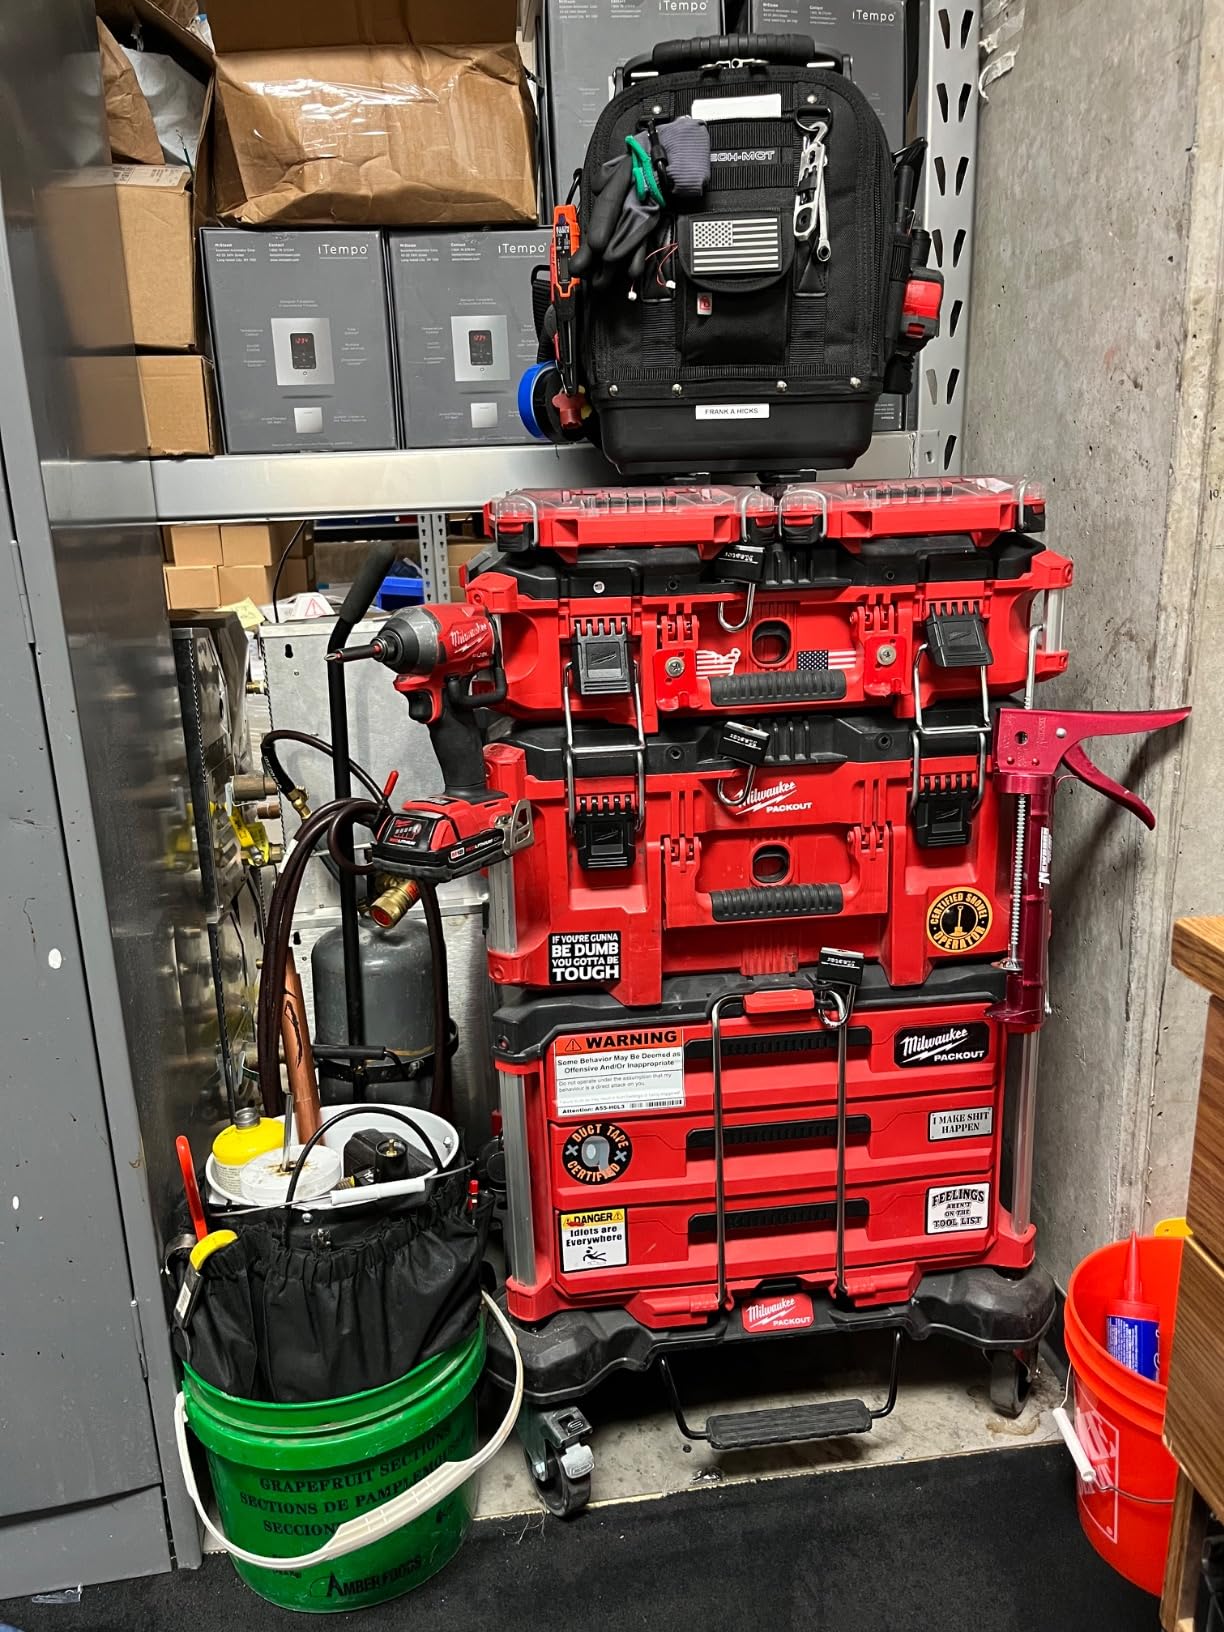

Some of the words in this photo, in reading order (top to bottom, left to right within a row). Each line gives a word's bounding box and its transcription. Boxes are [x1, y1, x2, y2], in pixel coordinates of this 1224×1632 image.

[852, 9, 896, 22] iTempo
[710, 150, 775, 162] ECH-MCT
[318, 244, 368, 256] iTempo
[498, 243, 546, 255] iTempo
[449, 622, 487, 647] Milwaukee
[766, 802, 812, 813] PACKOUT
[930, 892, 964, 925] CERTIFIED
[965, 893, 988, 920] SHOVEL
[552, 935, 560, 944] IF
[561, 934, 590, 943] YOU'RE
[590, 933, 618, 942] GUNNA
[933, 925, 986, 950] OPERATOR
[552, 944, 572, 957] BE
[574, 942, 619, 956] DUMB
[552, 958, 571, 967] YOU
[573, 957, 605, 966] GOTTA
[606, 956, 619, 964] BE
[552, 965, 619, 981] TOUGH
[585, 1030, 677, 1049] WARNING
[899, 1028, 969, 1056] Milwaukee
[580, 1056, 612, 1064] Behavior
[641, 1051, 671, 1059] Deemed
[933, 1050, 985, 1061] PACKOUT
[564, 1066, 599, 1074] Offensive
[600, 1062, 626, 1070] And/Or
[627, 1060, 675, 1068] Inappropriate
[932, 1117, 937, 1125] I
[938, 1113, 966, 1124] MAKE
[967, 1111, 990, 1120] SHIT
[942, 1122, 980, 1134] HAPPEN
[571, 1123, 602, 1143] DUCT
[606, 1125, 629, 1149] TAPE
[931, 1188, 985, 1207] FEELINGS
[946, 1201, 972, 1209] AREN'T
[573, 1212, 613, 1224] DANGER
[944, 1210, 954, 1218] ON
[932, 1218, 958, 1228] TOOL
[960, 1216, 982, 1225] LIST
[570, 1228, 599, 1238] Idiots
[601, 1225, 618, 1234] are
[566, 1233, 623, 1247] Everywhere
[745, 1297, 797, 1323] Milwaukee
[772, 1316, 812, 1326] PACKOUT
[260, 1468, 376, 1494] GRAPEFRUIT
[240, 1491, 318, 1515] SECTIONS
[323, 1498, 349, 1513] DE
